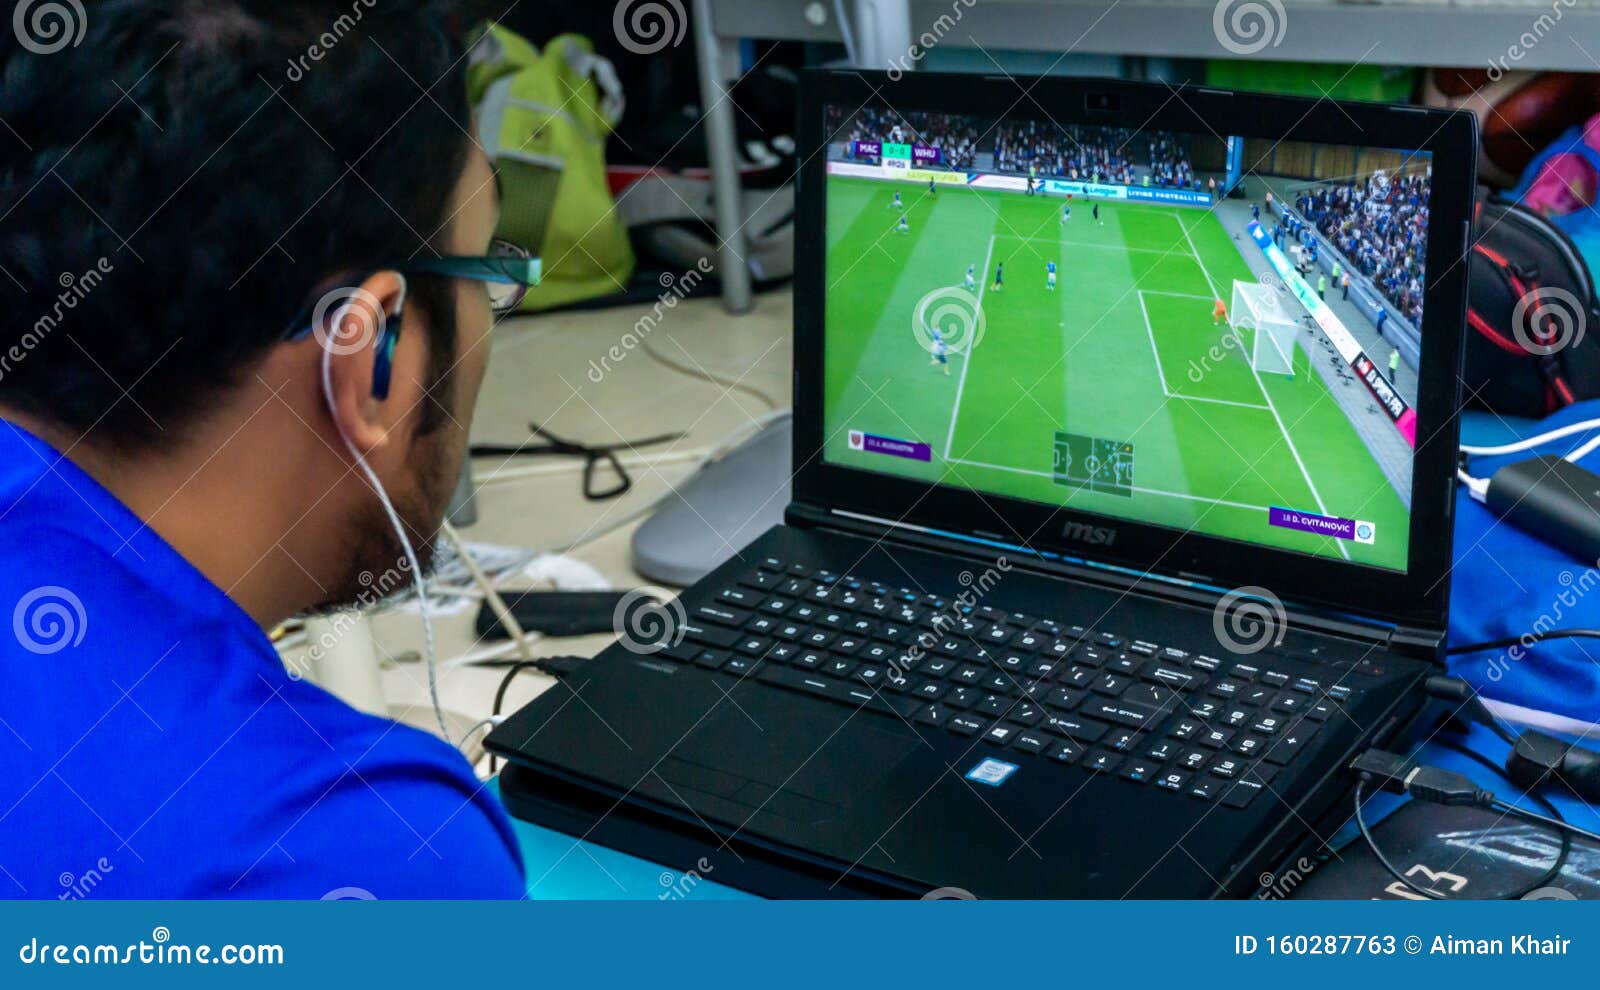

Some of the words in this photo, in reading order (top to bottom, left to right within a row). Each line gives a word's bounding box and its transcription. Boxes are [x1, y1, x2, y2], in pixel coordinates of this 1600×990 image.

[860, 143, 878, 154] MAC
[914, 148, 936, 158] WHU
[1301, 517, 1350, 533] CVITANOVIC
